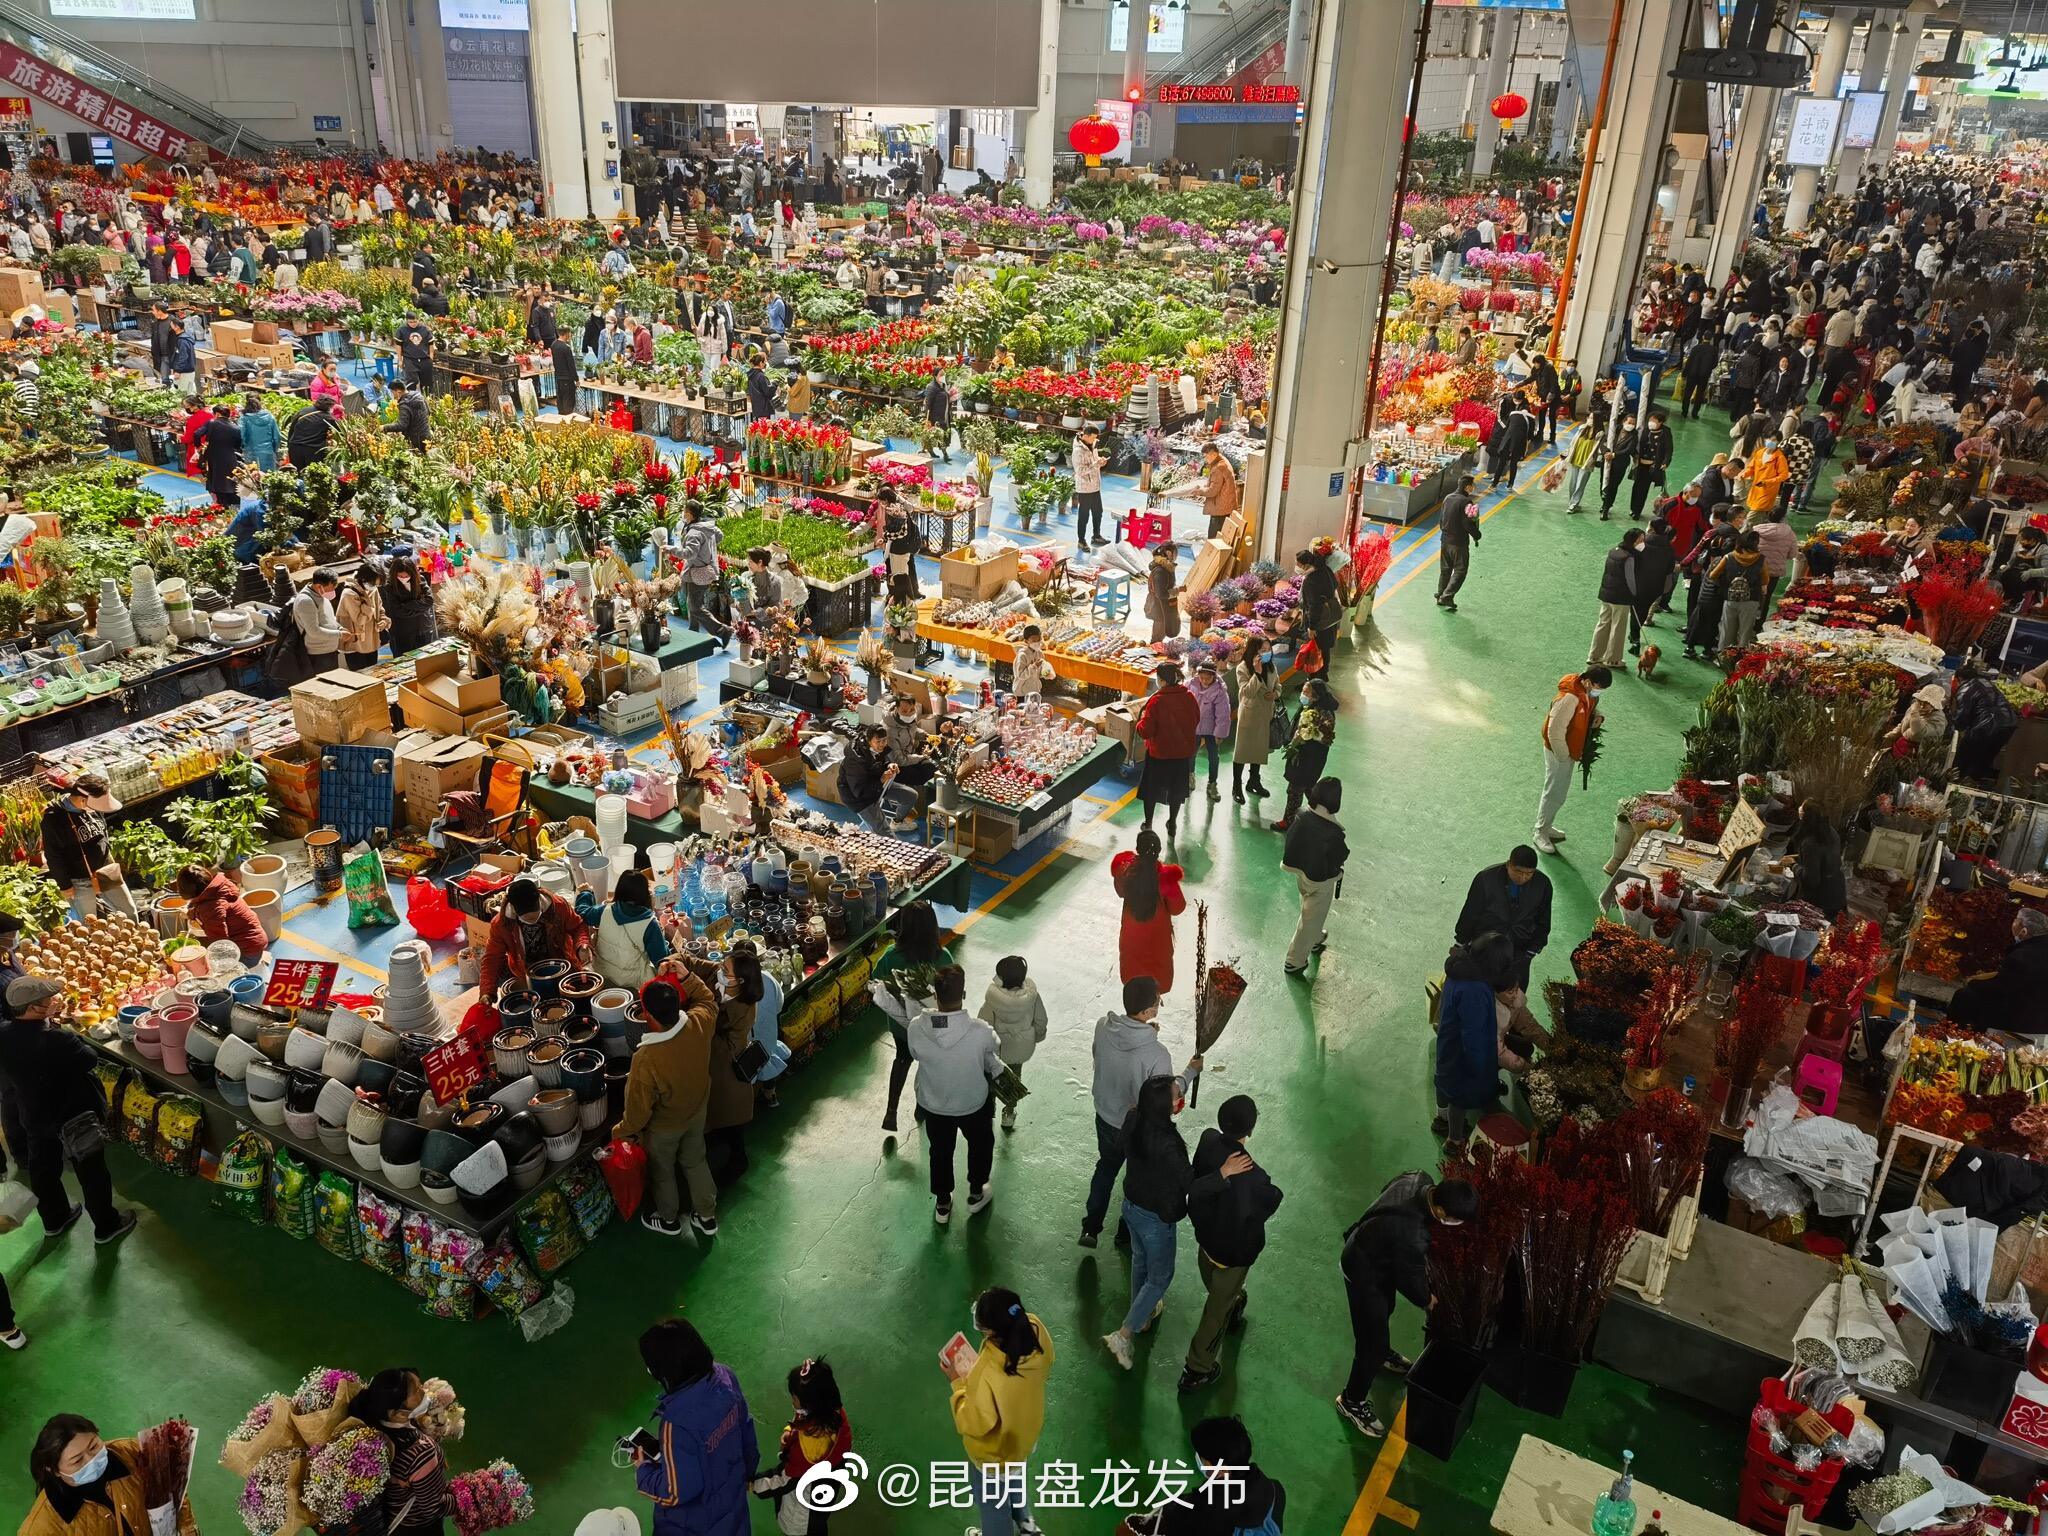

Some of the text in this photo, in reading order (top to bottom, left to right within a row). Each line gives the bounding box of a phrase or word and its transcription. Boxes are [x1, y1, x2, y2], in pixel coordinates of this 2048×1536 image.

[8, 56, 186, 157] 旅游精品超市
[1801, 116, 1830, 131] 斗南
[1799, 132, 1828, 146] 花城
[274, 961, 324, 978] 三件套
[268, 982, 313, 1006] 25元
[426, 1036, 470, 1074] 三件套
[436, 1065, 480, 1101] 25元
